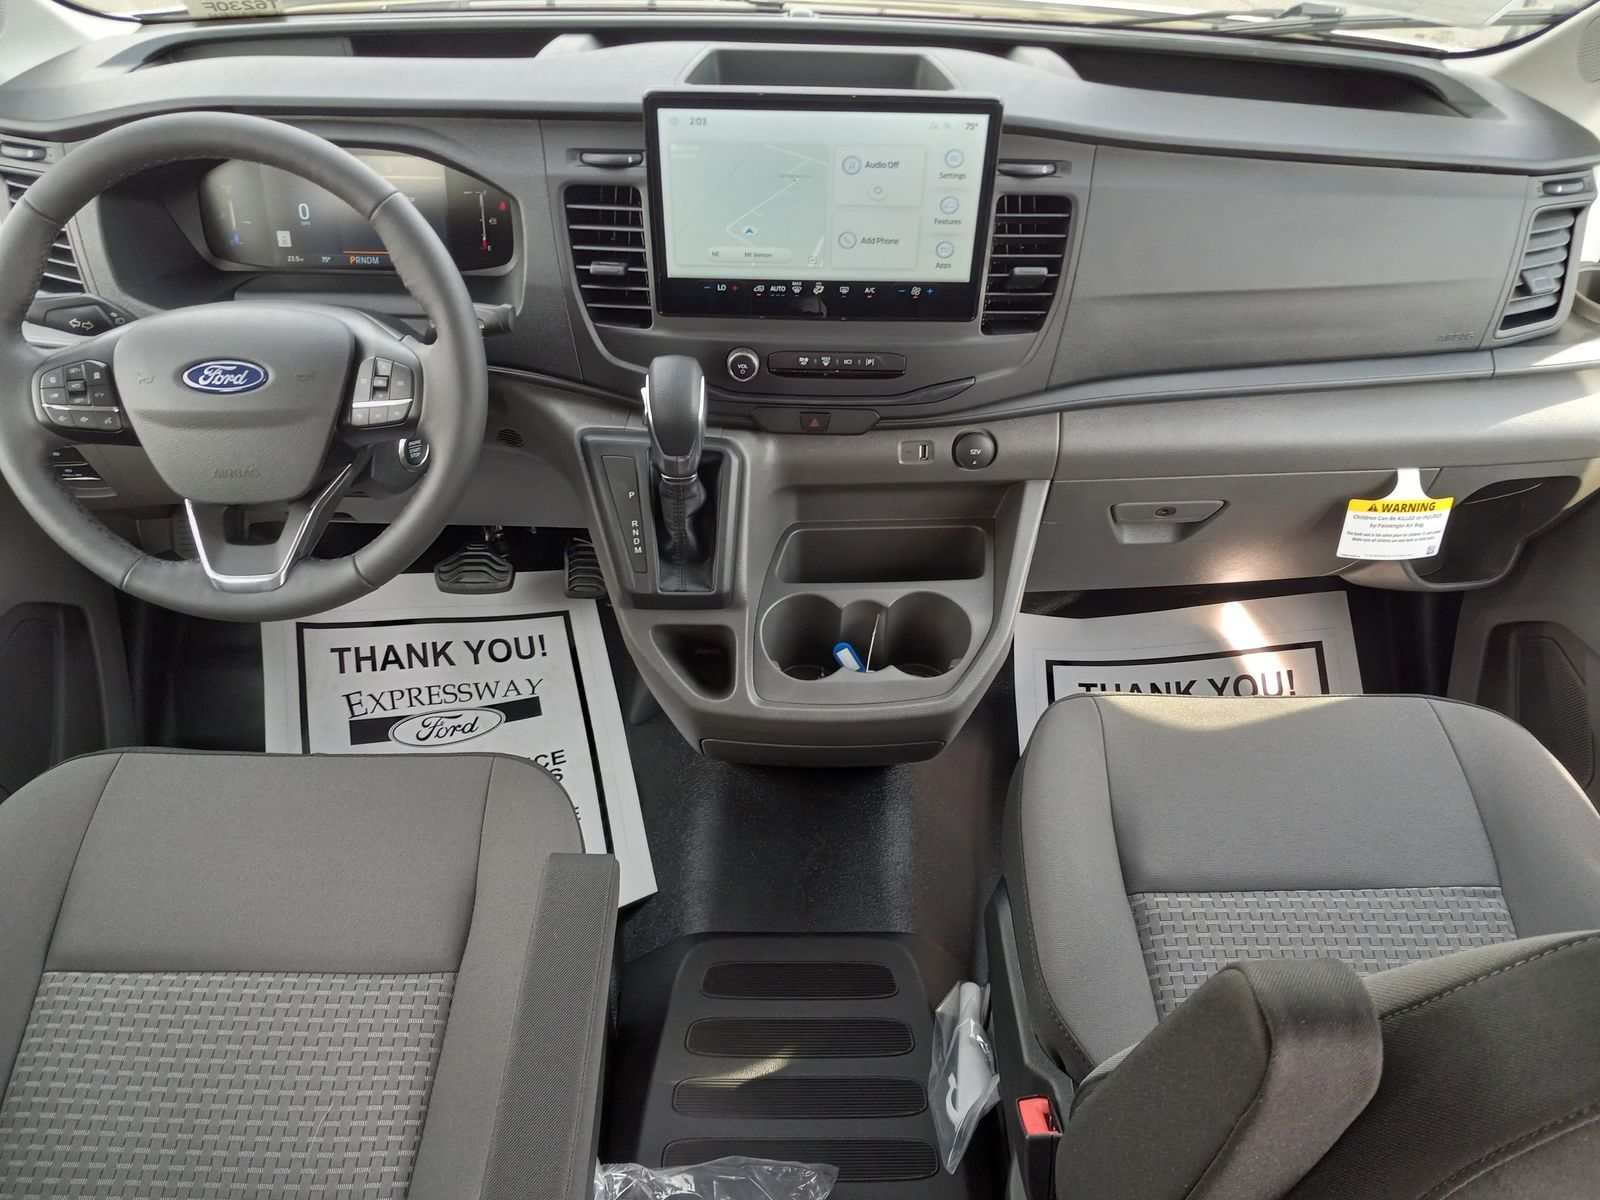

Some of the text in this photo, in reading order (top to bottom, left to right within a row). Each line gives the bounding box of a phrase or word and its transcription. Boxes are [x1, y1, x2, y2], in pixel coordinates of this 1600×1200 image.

[689, 117, 707, 126] 2:03
[865, 161, 899, 169] Audio Off
[939, 172, 966, 180] Settings
[298, 203, 309, 220] 0
[861, 237, 899, 245] Add Phone
[935, 262, 951, 270] Apps
[198, 364, 248, 387] Ford
[1382, 502, 1436, 512] WARNING
[634, 546, 642, 554] M
[330, 634, 548, 674] THANK YOU!
[1206, 670, 1296, 696] YOU!
[342, 678, 544, 720] EXPRESSWAY
[415, 713, 480, 742] Ford
